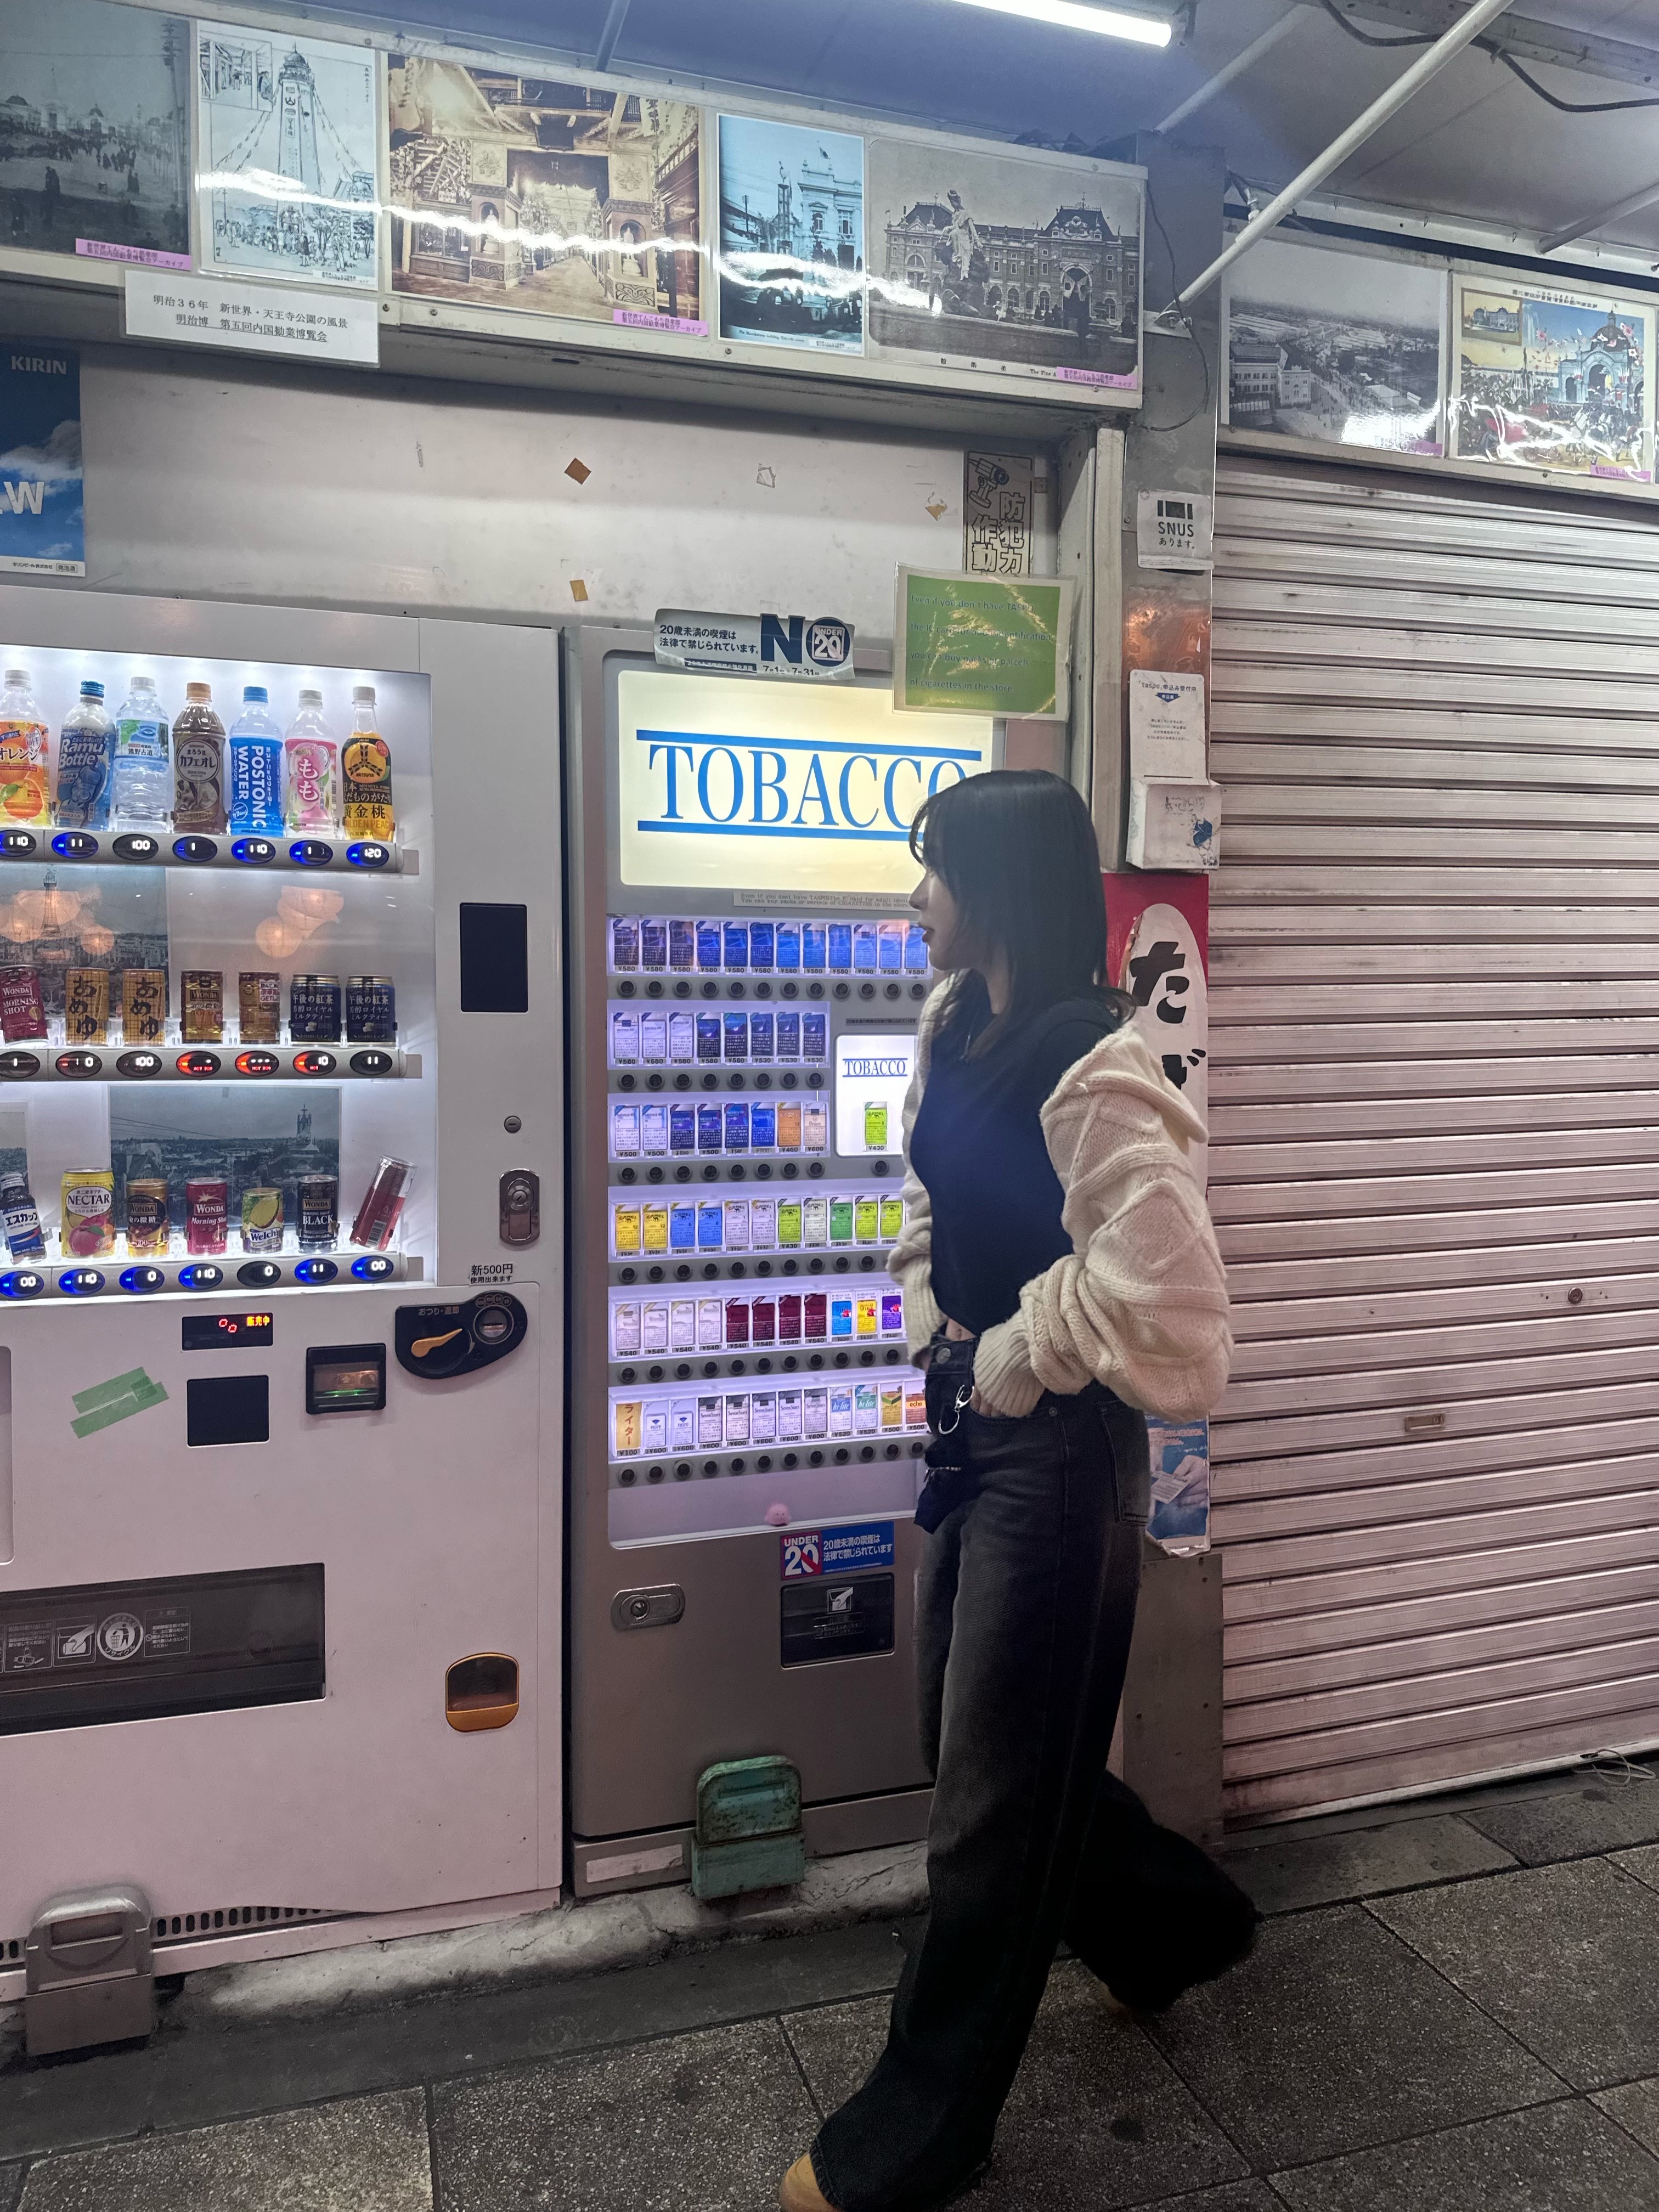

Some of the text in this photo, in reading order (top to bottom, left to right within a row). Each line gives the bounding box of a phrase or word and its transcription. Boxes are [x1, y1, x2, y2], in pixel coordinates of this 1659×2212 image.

[220, 303, 348, 329] 新世界・天王寺公園の風景
[176, 314, 327, 341] 明治博 第五回内国勧業博覧会
[11, 356, 66, 374] KIRIN
[1158, 521, 1194, 538] SNUS
[1159, 538, 1195, 549] あります。
[911, 595, 929, 604] Even
[933, 596, 938, 605] if
[959, 599, 982, 608] don't
[984, 601, 1004, 610] have
[660, 624, 736, 640] 20歳未満の喫煙は
[814, 628, 843, 636] UNDER
[910, 623, 924, 631] the
[659, 637, 759, 654] 法律で禁じられています。
[910, 652, 925, 660] you
[945, 651, 960, 663] buy
[1001, 658, 1029, 670] parcels
[921, 680, 962, 690] cigarettes
[61, 738, 103, 753] Ramu
[128, 748, 153, 757] 熊野古道
[59, 752, 96, 769] Bottle
[179, 755, 216, 768] カフェオレ
[238, 746, 249, 800] WATER
[298, 758, 318, 801] もも
[251, 746, 267, 828] POSTONIC
[343, 782, 357, 792] 日本
[344, 793, 391, 804] くだものがたり
[345, 804, 386, 819] 黄金桃
[132, 840, 150, 850] 100
[364, 848, 382, 858] 120
[2, 987, 30, 996] WONDA
[191, 990, 218, 1000] WONDA
[3, 998, 39, 1008] MORNING
[293, 994, 333, 1005] 午後の紅茶
[349, 995, 389, 1005] 午後の紅茶
[4, 1006, 26, 1016] SHOT
[69, 975, 98, 1041] あめゆ
[131, 976, 159, 1041] あめゆ
[136, 1057, 154, 1067] 100
[845, 1060, 906, 1075] TOBACCO
[67, 1194, 110, 1205] NECTAR
[196, 1204, 224, 1213] WONDA
[6, 1212, 38, 1226] エスカップ
[191, 1217, 217, 1226] Morning
[303, 1214, 334, 1225] BLACK
[471, 1263, 513, 1276] 新500円
[471, 1275, 512, 1284] 使用出来ます
[419, 1306, 460, 1316] おつり・返却
[624, 1404, 634, 1446] ライター
[783, 1535, 819, 1547] UNDER
[823, 1534, 881, 1550] 20歳未満の喫煙は
[823, 1543, 893, 1562] 法律で禁じられています
[784, 1543, 820, 1577] 20
